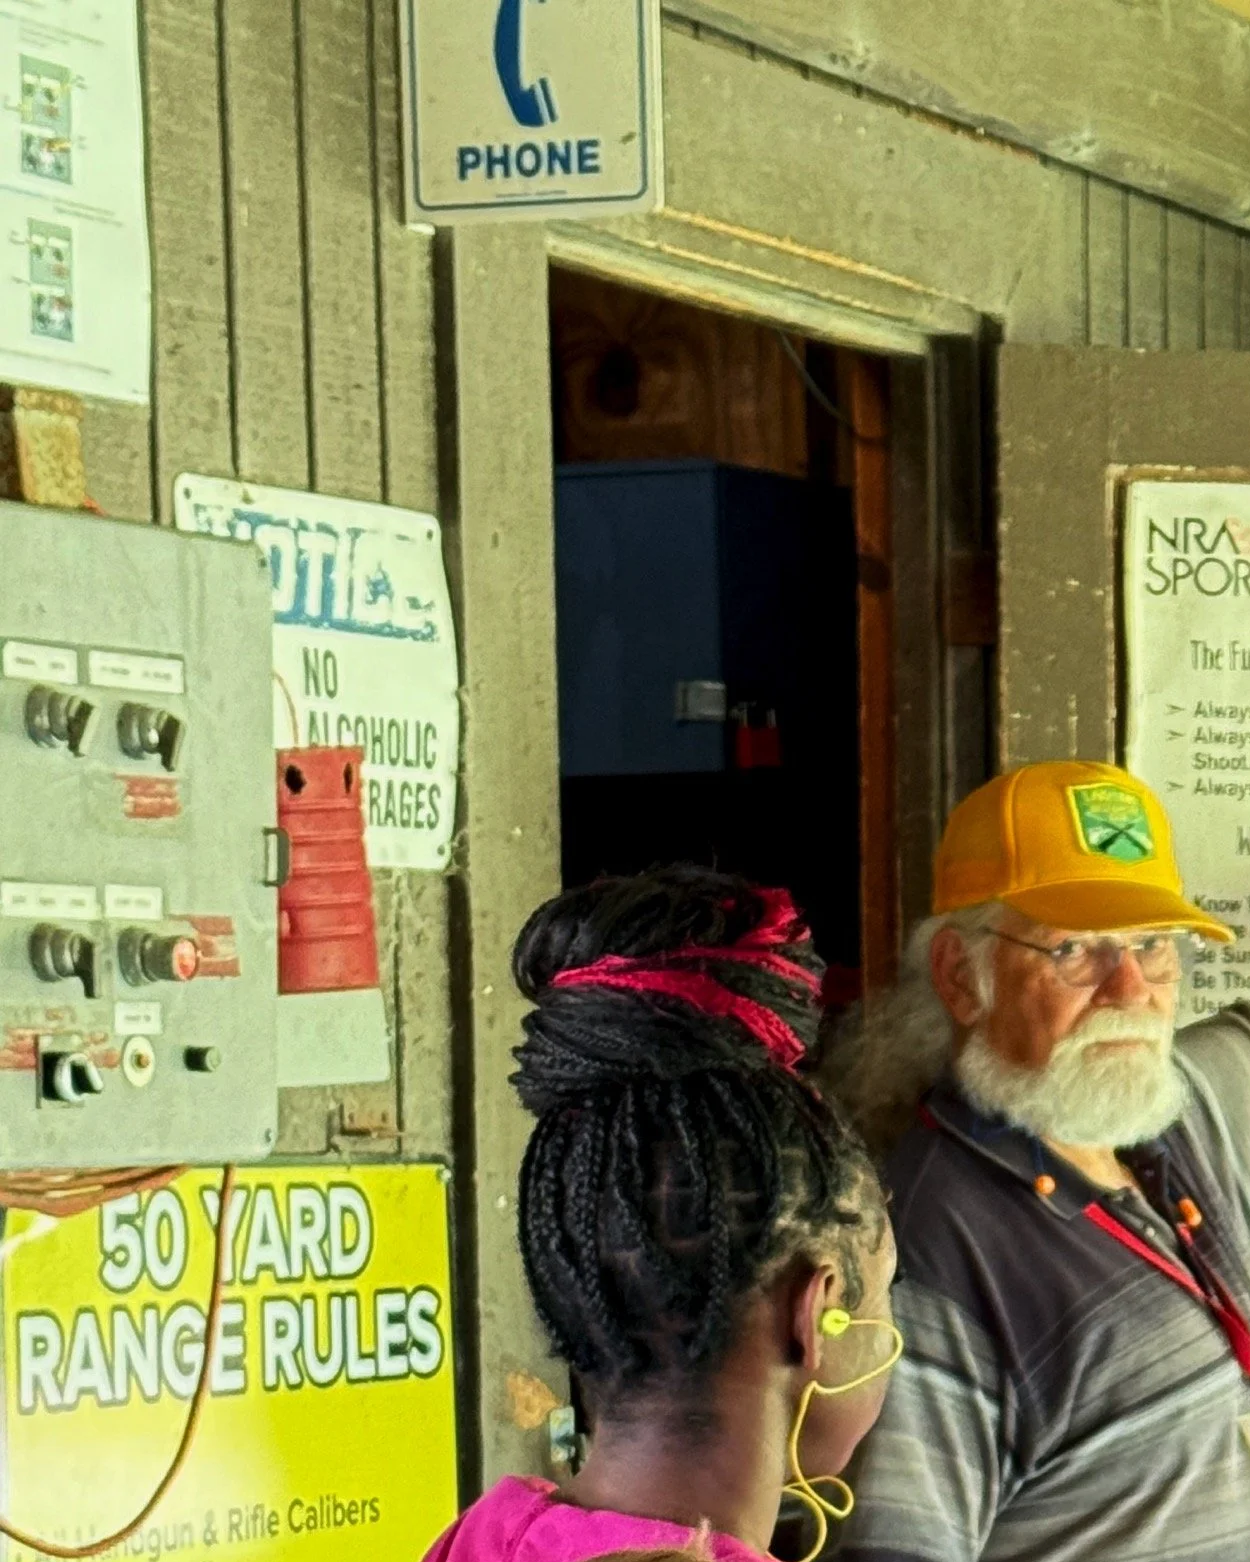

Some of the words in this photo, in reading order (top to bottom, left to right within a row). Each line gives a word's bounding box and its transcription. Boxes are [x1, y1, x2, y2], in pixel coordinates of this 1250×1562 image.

[457, 139, 601, 181] PHONE
[1148, 517, 1240, 555] NRA
[302, 646, 338, 699] NO
[1190, 640, 1223, 671] The
[1192, 970, 1217, 989] Be
[101, 1188, 190, 1292] 50
[201, 1180, 373, 1288] YARD
[16, 1298, 247, 1414] RANGE
[260, 1285, 445, 1390] RULES
[202, 1510, 218, 1546] &
[227, 1502, 280, 1543] Rifle
[287, 1496, 382, 1534] Calibers
